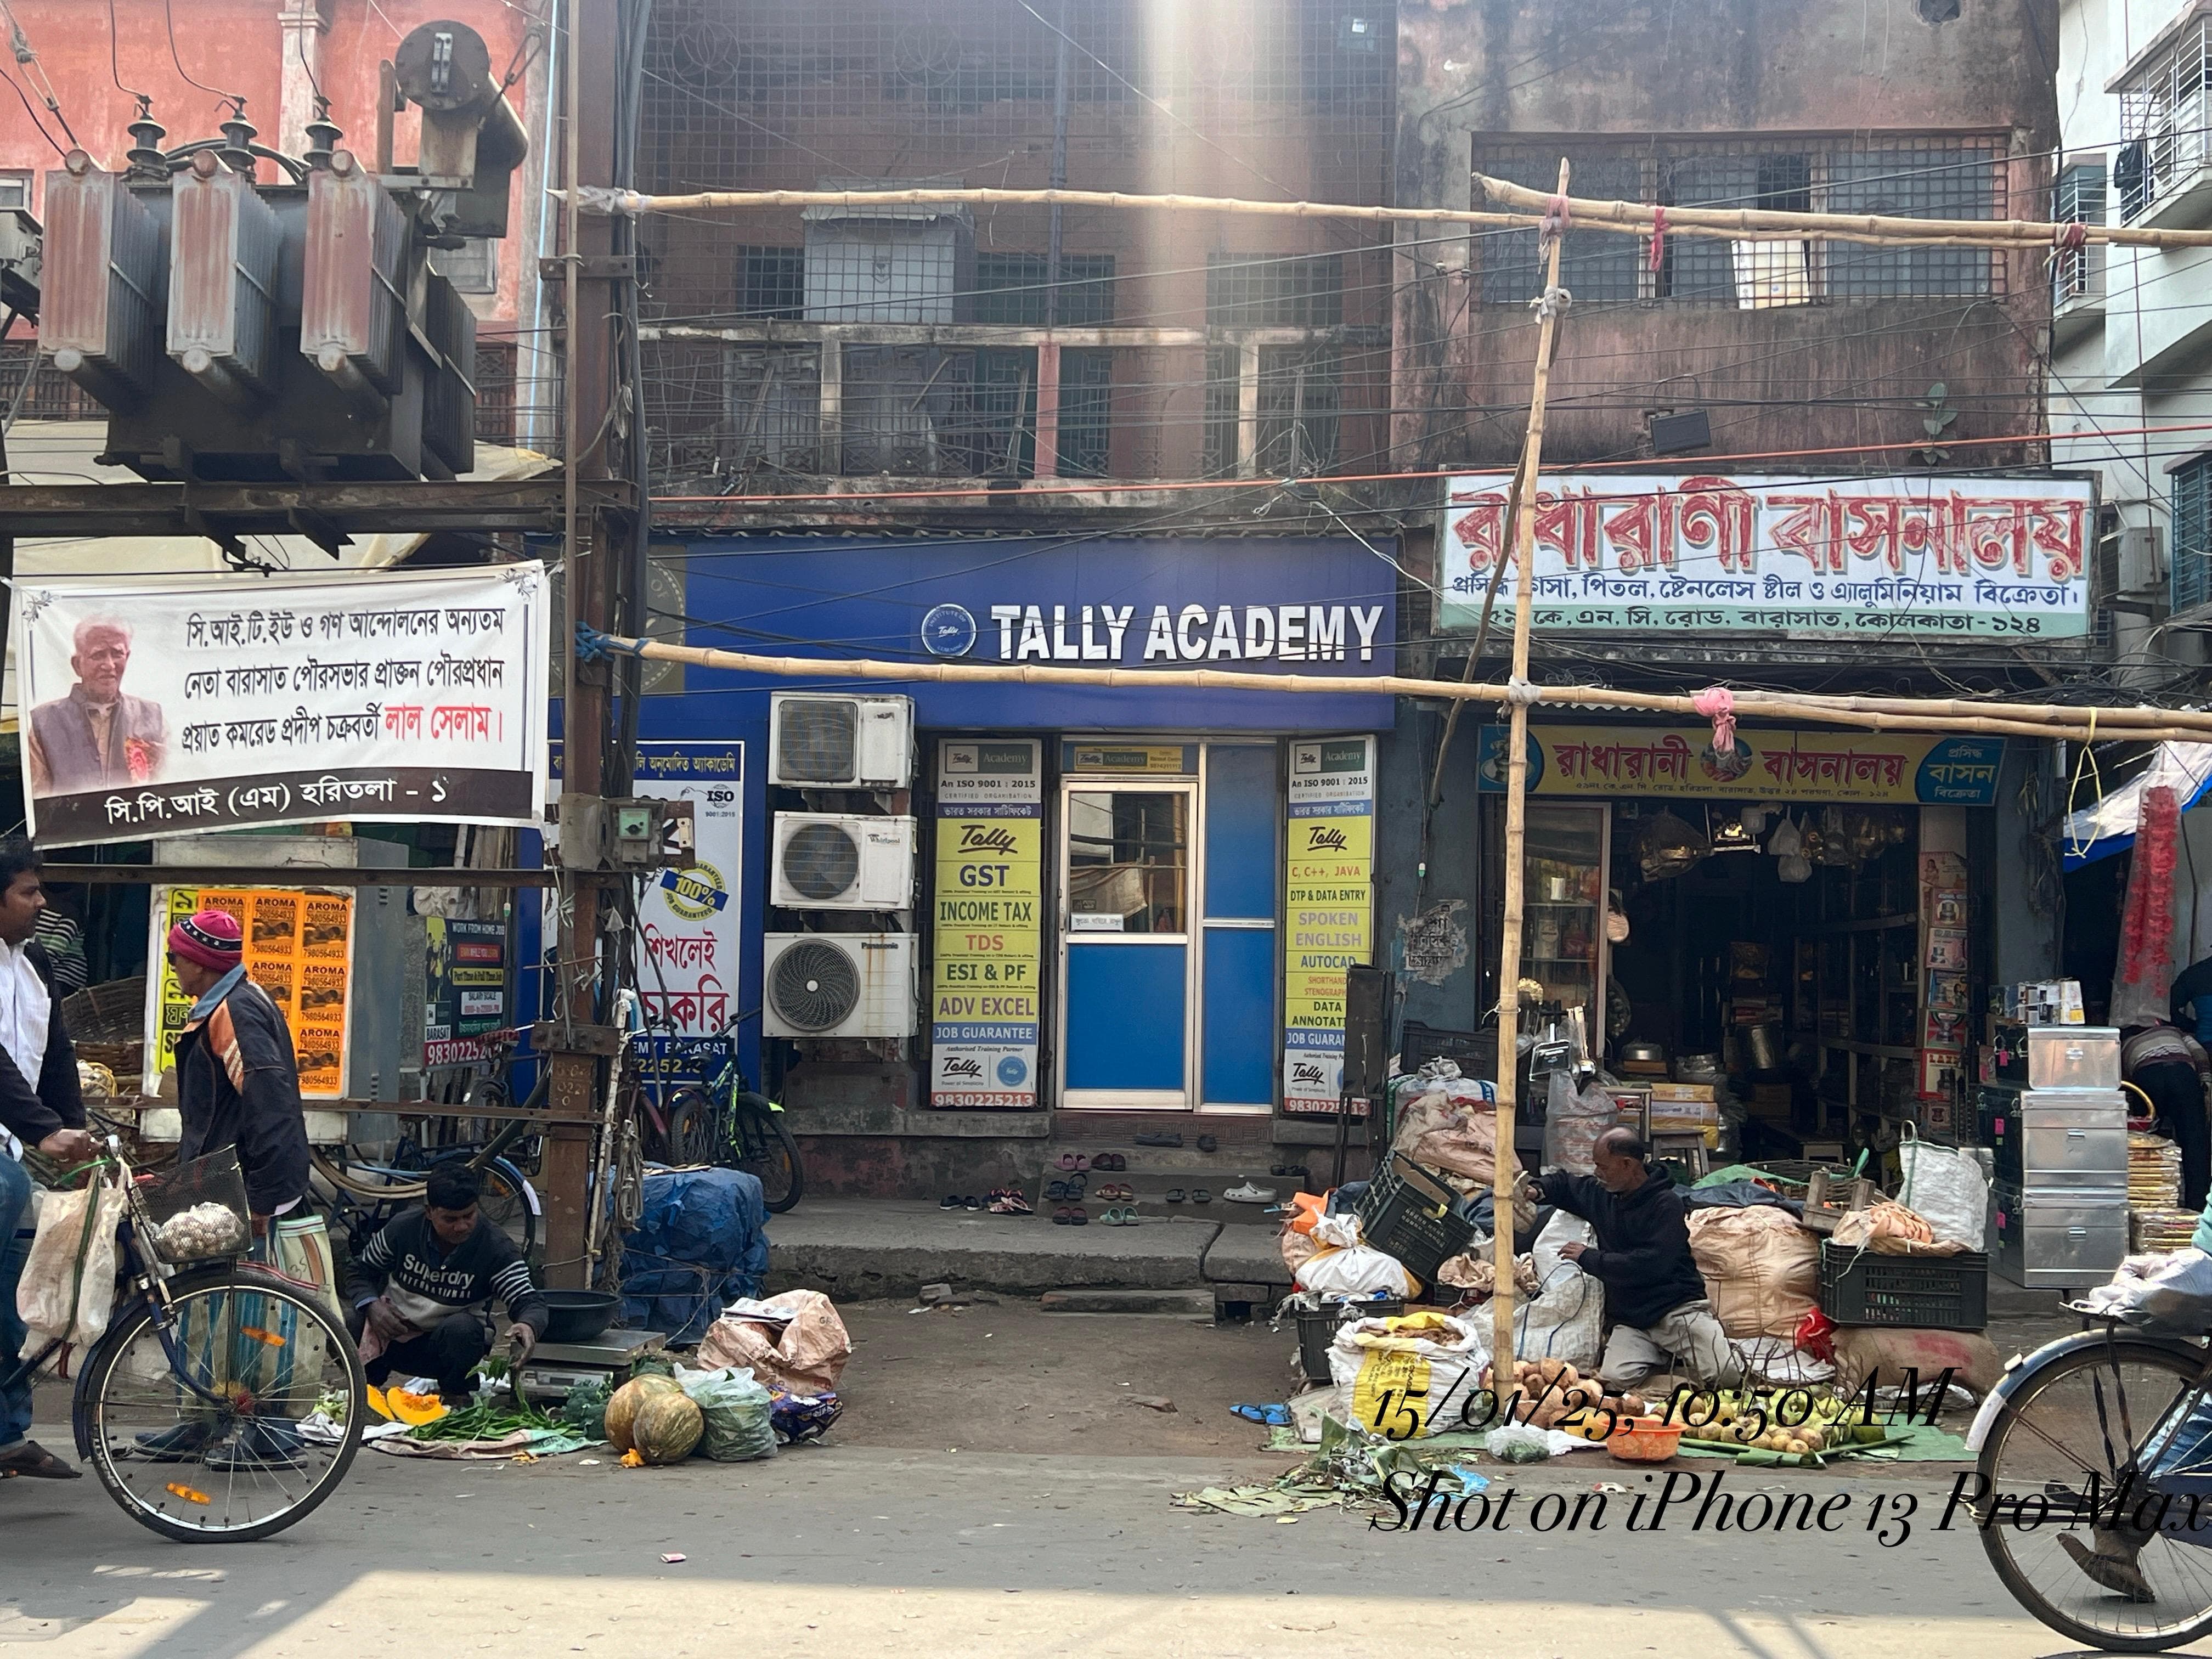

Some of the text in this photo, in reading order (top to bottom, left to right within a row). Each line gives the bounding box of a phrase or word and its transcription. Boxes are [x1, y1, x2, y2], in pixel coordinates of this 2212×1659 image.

[1768, 487, 2092, 578] বাসনালয়
[1809, 582, 1824, 600] ও
[301, 618, 312, 637] ও
[320, 611, 344, 640] গণ
[349, 609, 441, 637] আন্দোলনের
[444, 608, 506, 635] অন্যতম
[991, 604, 1384, 661] TALLY ACADEMY
[185, 652, 505, 699] নেতা বারাসাত পৌরসভার প্রাক্তন পৌরপ্রধান
[182, 720, 221, 755] প্রয়াত
[224, 718, 278, 752] কমরেড
[281, 706, 322, 746] প্রদীপ
[327, 702, 383, 742] চক্রবর্তী
[385, 702, 425, 741] লাল
[984, 751, 1028, 766] Academy
[1104, 753, 1146, 764] Academy
[1325, 751, 1362, 764] Academy
[1927, 763, 1995, 783] বাসন
[978, 780, 1001, 788] 9001
[1012, 780, 1035, 788] 2015
[1304, 779, 1318, 787] ISO
[1321, 778, 1340, 786] 9001
[1347, 776, 1368, 785] 2015
[228, 783, 290, 816] (এম)
[300, 775, 397, 806] হরিতলা
[707, 791, 734, 802] ISO
[958, 825, 1018, 855] Tally
[1307, 826, 1347, 851] Tally
[960, 865, 1009, 887] GST
[1335, 866, 1361, 877] JAVA
[675, 877, 715, 906] 100%
[1290, 889, 1365, 901] DTP & DATA ENTRY
[205, 897, 244, 906] AROMA
[256, 897, 296, 908] AROMA
[306, 902, 347, 912] AROMA
[940, 901, 1032, 922] INCOME TAX
[1299, 912, 1358, 926] SPOKEN
[965, 934, 1004, 951] TDS
[1296, 933, 1362, 947] ENGLISH
[252, 961, 292, 971] AROMA
[1301, 955, 1356, 968] AUTOCAD
[304, 966, 345, 975] AROMA
[947, 964, 1026, 981] ESI & PF
[939, 997, 1035, 1016] ADV EXCEL
[1314, 1001, 1342, 1012] DATA
[300, 1028, 340, 1038] AROMA
[936, 1027, 1032, 1039] JOB GUARANTEE
[1286, 1032, 1305, 1045] JOB
[941, 1057, 982, 1078] Tally
[1292, 1062, 1325, 1085] Tally
[934, 1094, 1034, 1107] 9830225213
[403, 1253, 475, 1289] Superdry
